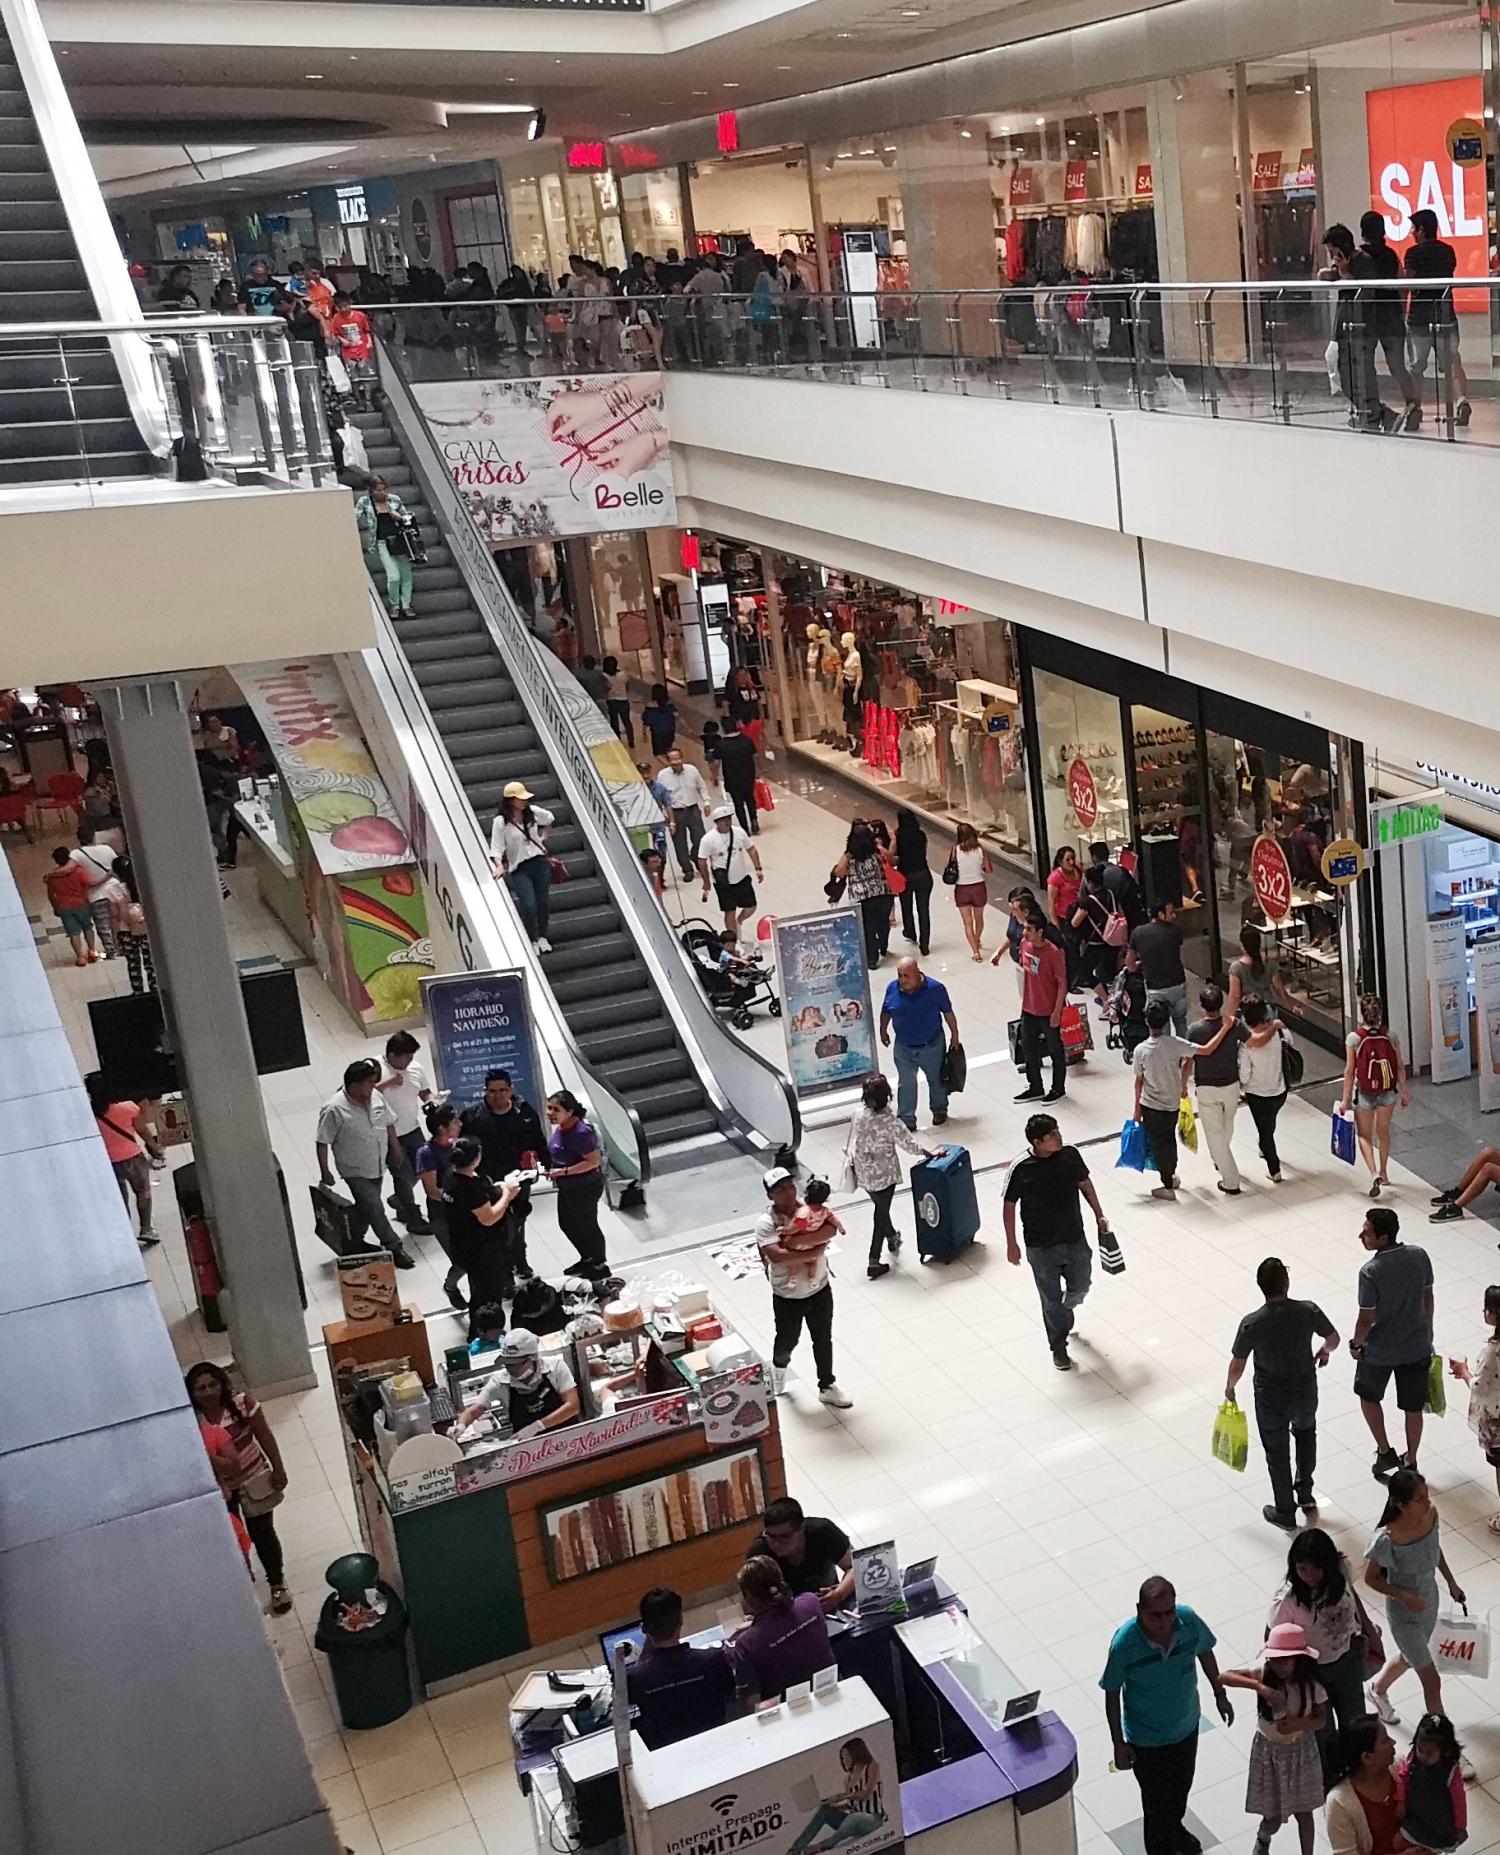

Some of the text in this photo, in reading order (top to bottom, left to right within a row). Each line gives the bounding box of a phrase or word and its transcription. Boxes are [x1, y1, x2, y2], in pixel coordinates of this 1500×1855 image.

[1067, 172, 1085, 189] SALE
[1257, 162, 1279, 178] SALE
[1012, 178, 1030, 194] SALE
[338, 197, 369, 224] PLACE
[595, 482, 664, 510] Belle
[542, 686, 611, 840] INTELIGENTE
[1073, 781, 1095, 813] 3x2
[1258, 864, 1287, 902] 3x2
[453, 1016, 509, 1032] NAVIDEÑO
[454, 1004, 504, 1019] HORARIO
[508, 1437, 567, 1473] Dulce
[667, 1823, 722, 1853] Internet
[725, 1801, 781, 1830] Prepago
[676, 1813, 783, 1855] IMITADO
